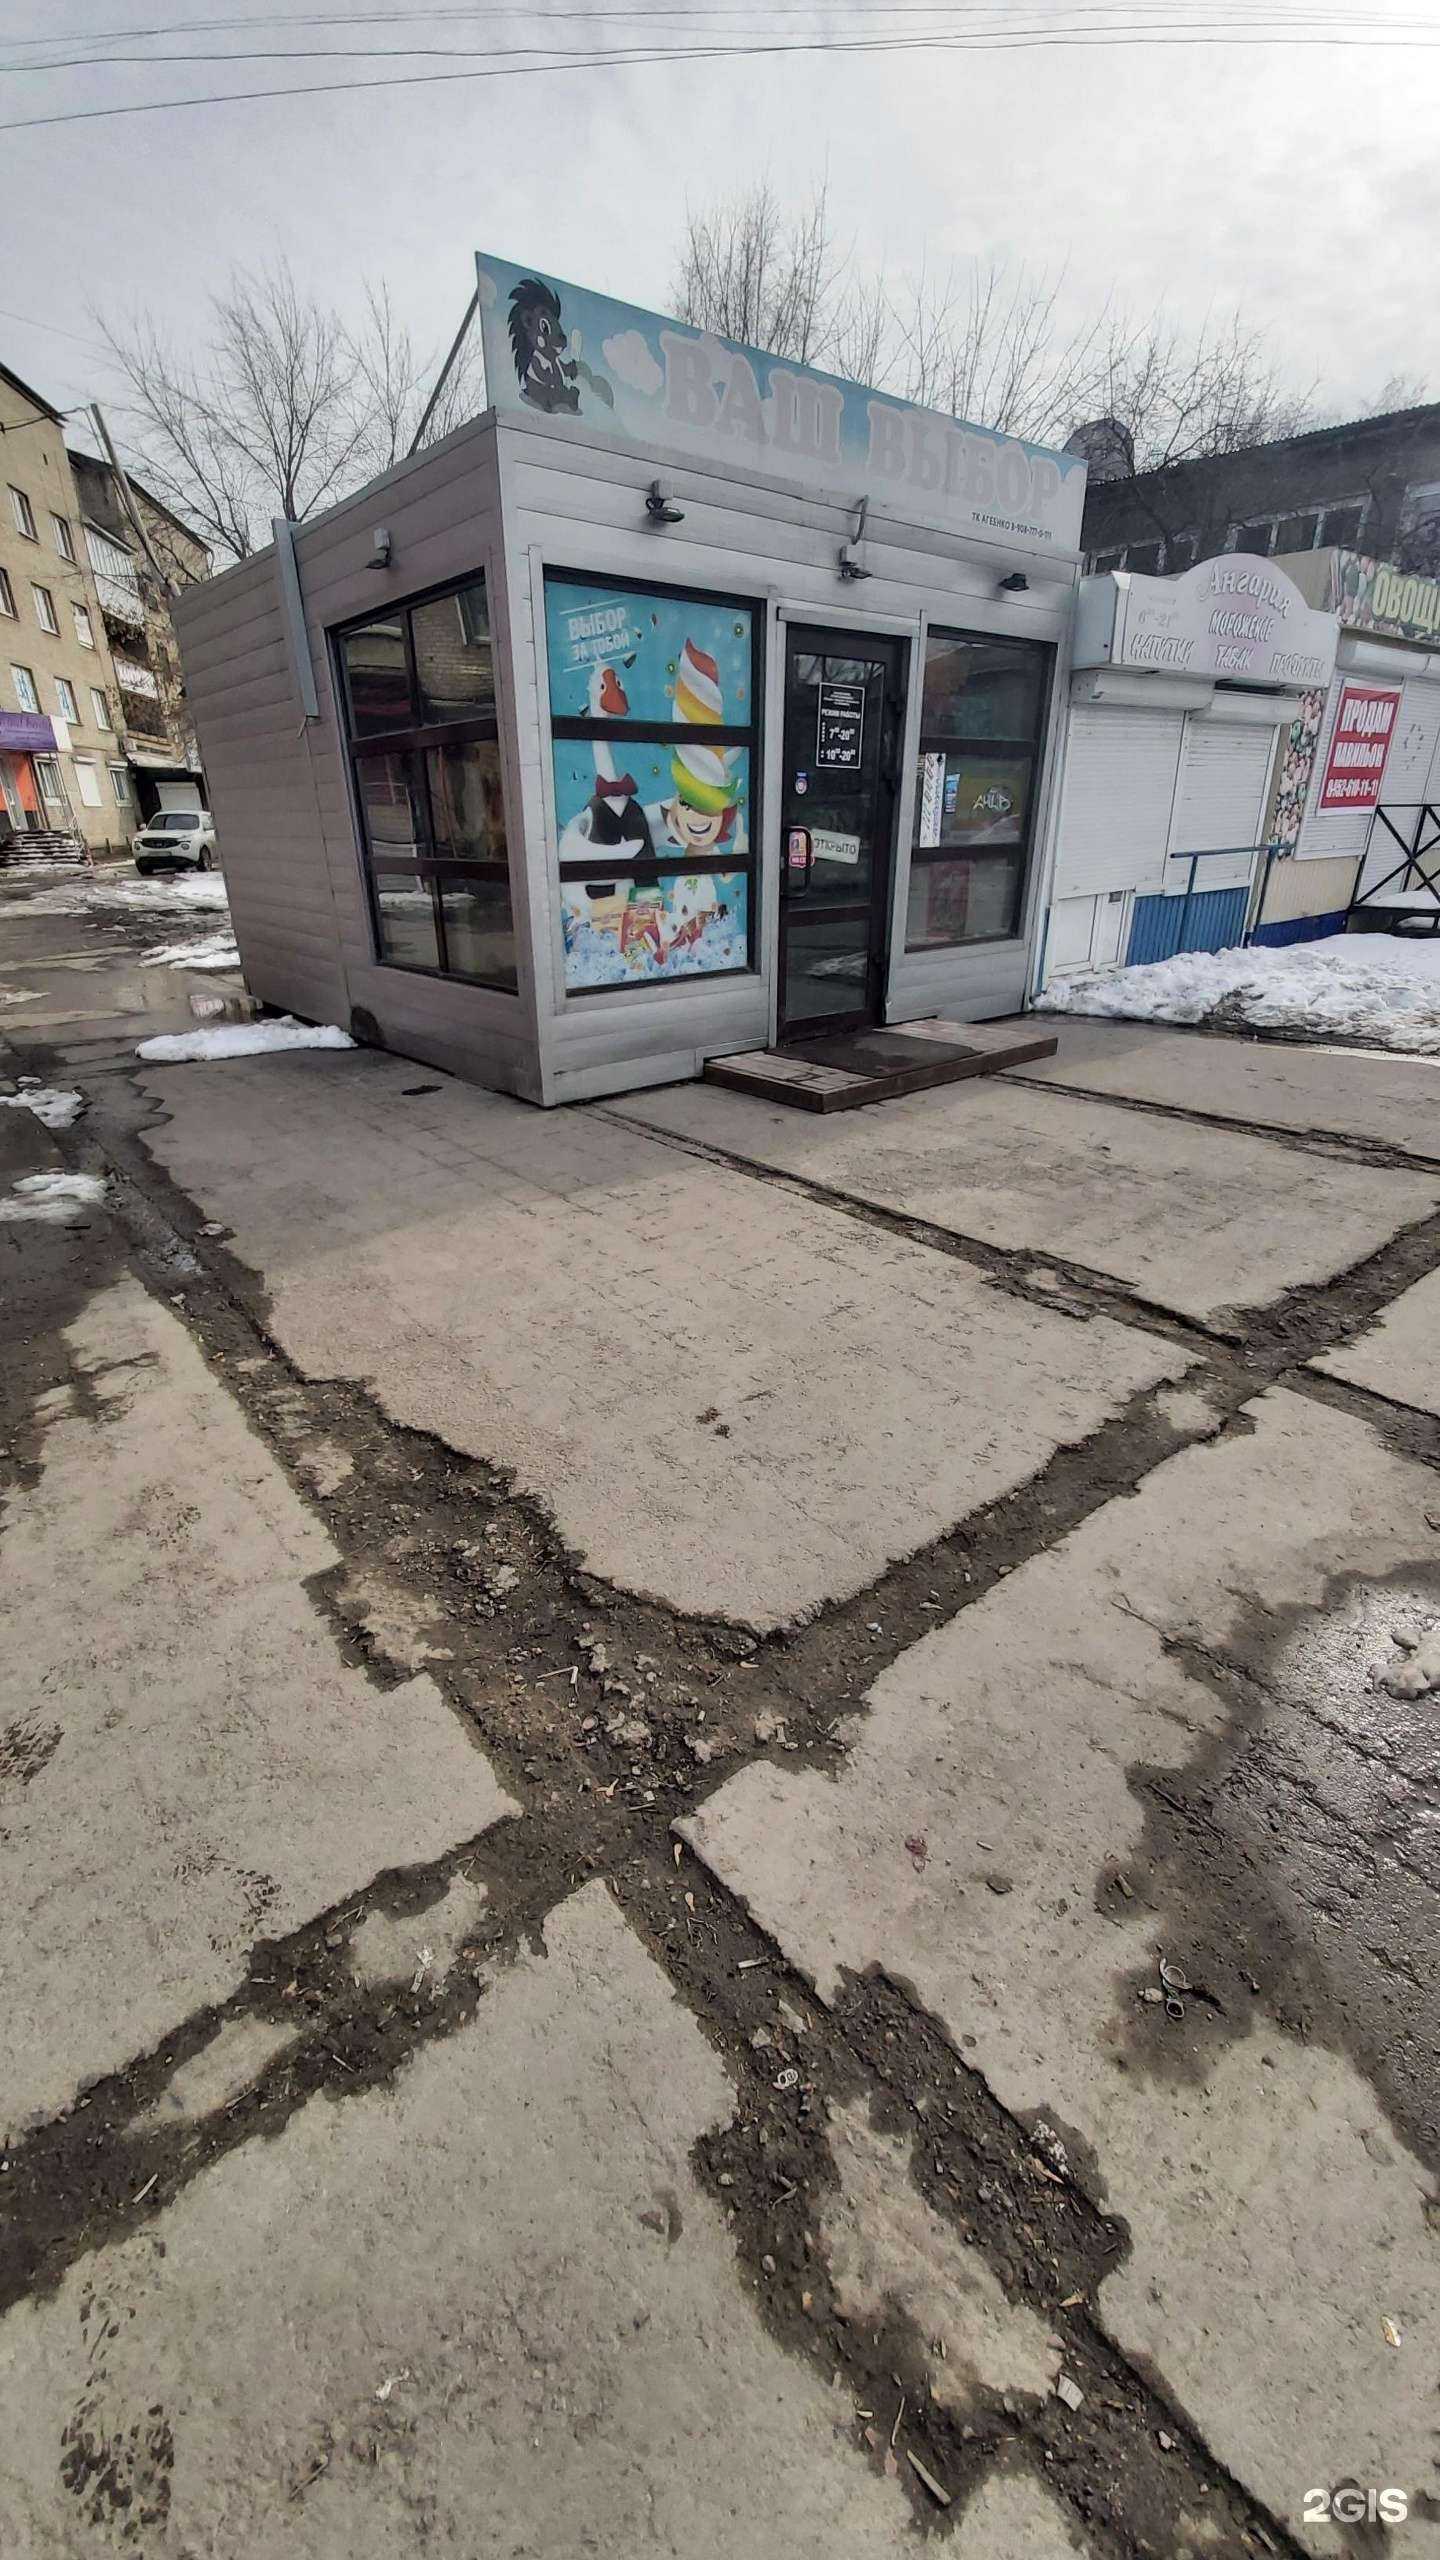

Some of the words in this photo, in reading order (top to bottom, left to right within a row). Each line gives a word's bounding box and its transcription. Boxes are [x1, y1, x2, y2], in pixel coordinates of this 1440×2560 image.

[660, 331, 845, 464] ВАШ
[867, 401, 1064, 518] ВЫБОР
[1372, 570, 1440, 635] ОВОЩ
[568, 607, 625, 640] ВЫБОР
[1340, 698, 1394, 738] ПРОДАМ
[1333, 741, 1385, 768] ПАВИЛЬОН
